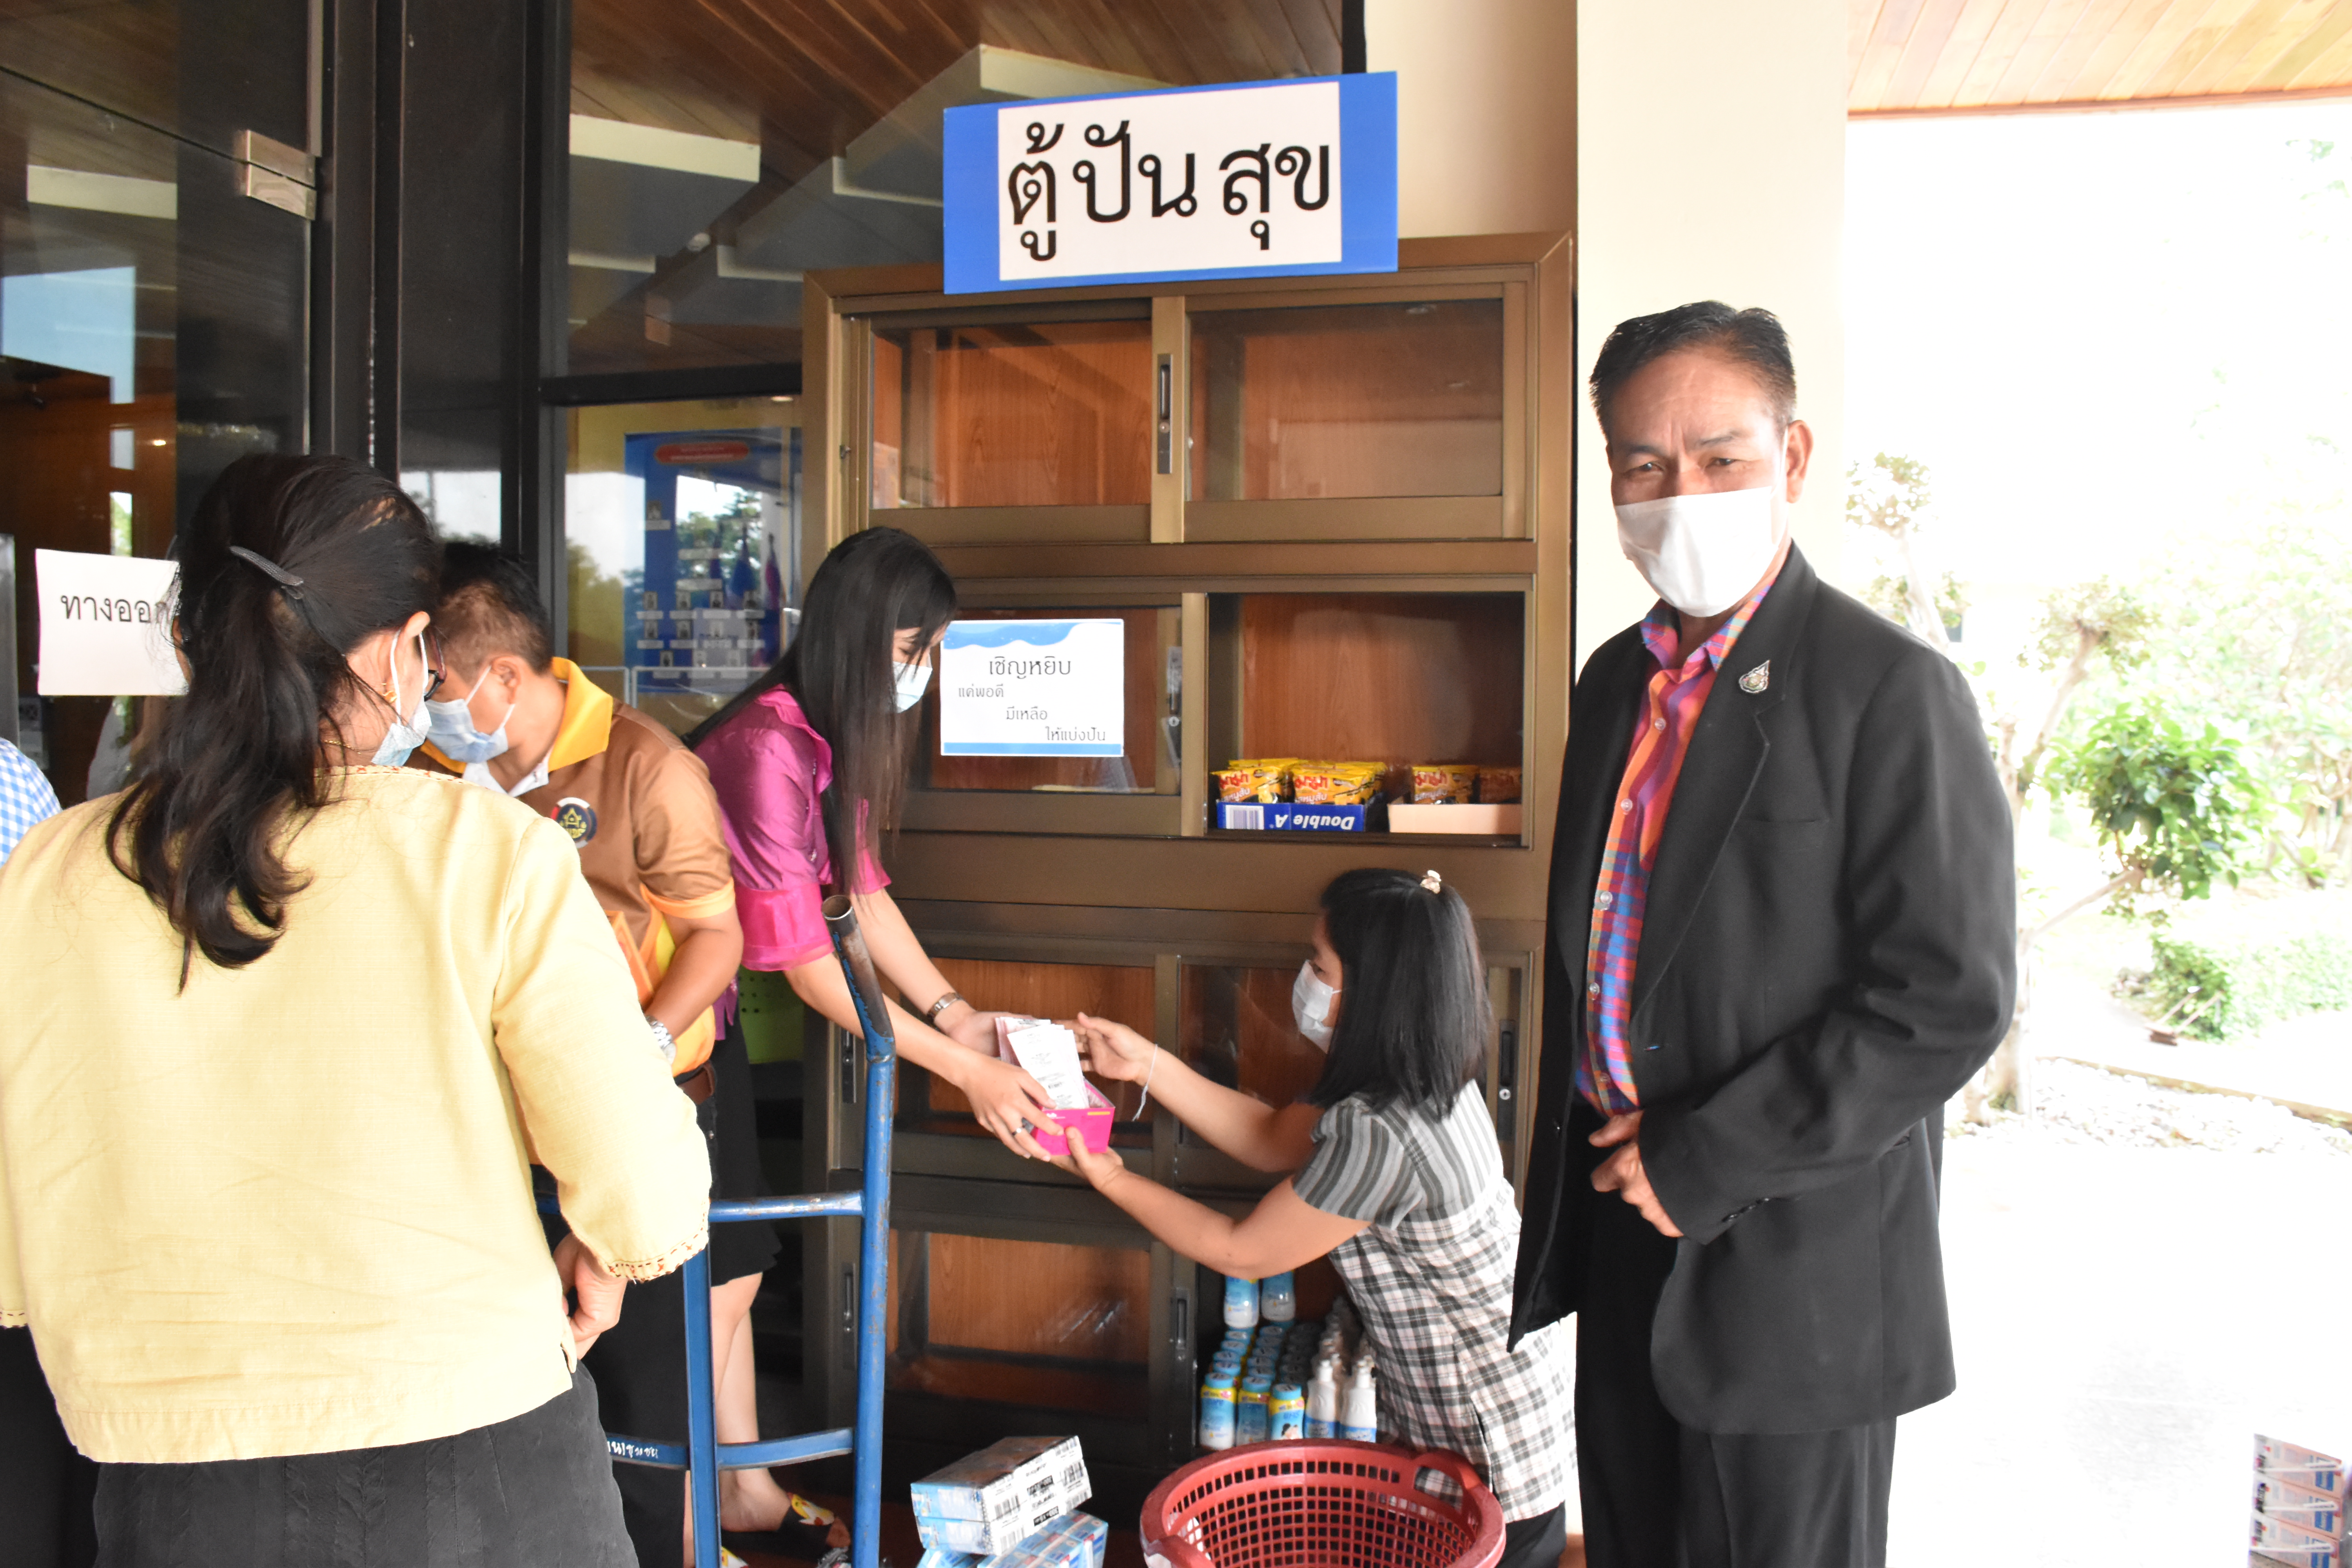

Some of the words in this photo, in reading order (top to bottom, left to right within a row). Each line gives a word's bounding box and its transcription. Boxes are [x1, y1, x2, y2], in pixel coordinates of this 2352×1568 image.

[1008, 122, 1064, 261] ตู้
[1072, 120, 1198, 223] ปัน
[1219, 143, 1330, 250] สุข
[989, 656, 1071, 679] เชิญหยิบ
[958, 683, 1004, 697] แค่พอดี
[1006, 706, 1048, 720] มีเหลือ
[1045, 726, 1105, 741] ให้แบ่งปัน
[1275, 814, 1289, 828] A
[1293, 815, 1355, 830] Double
